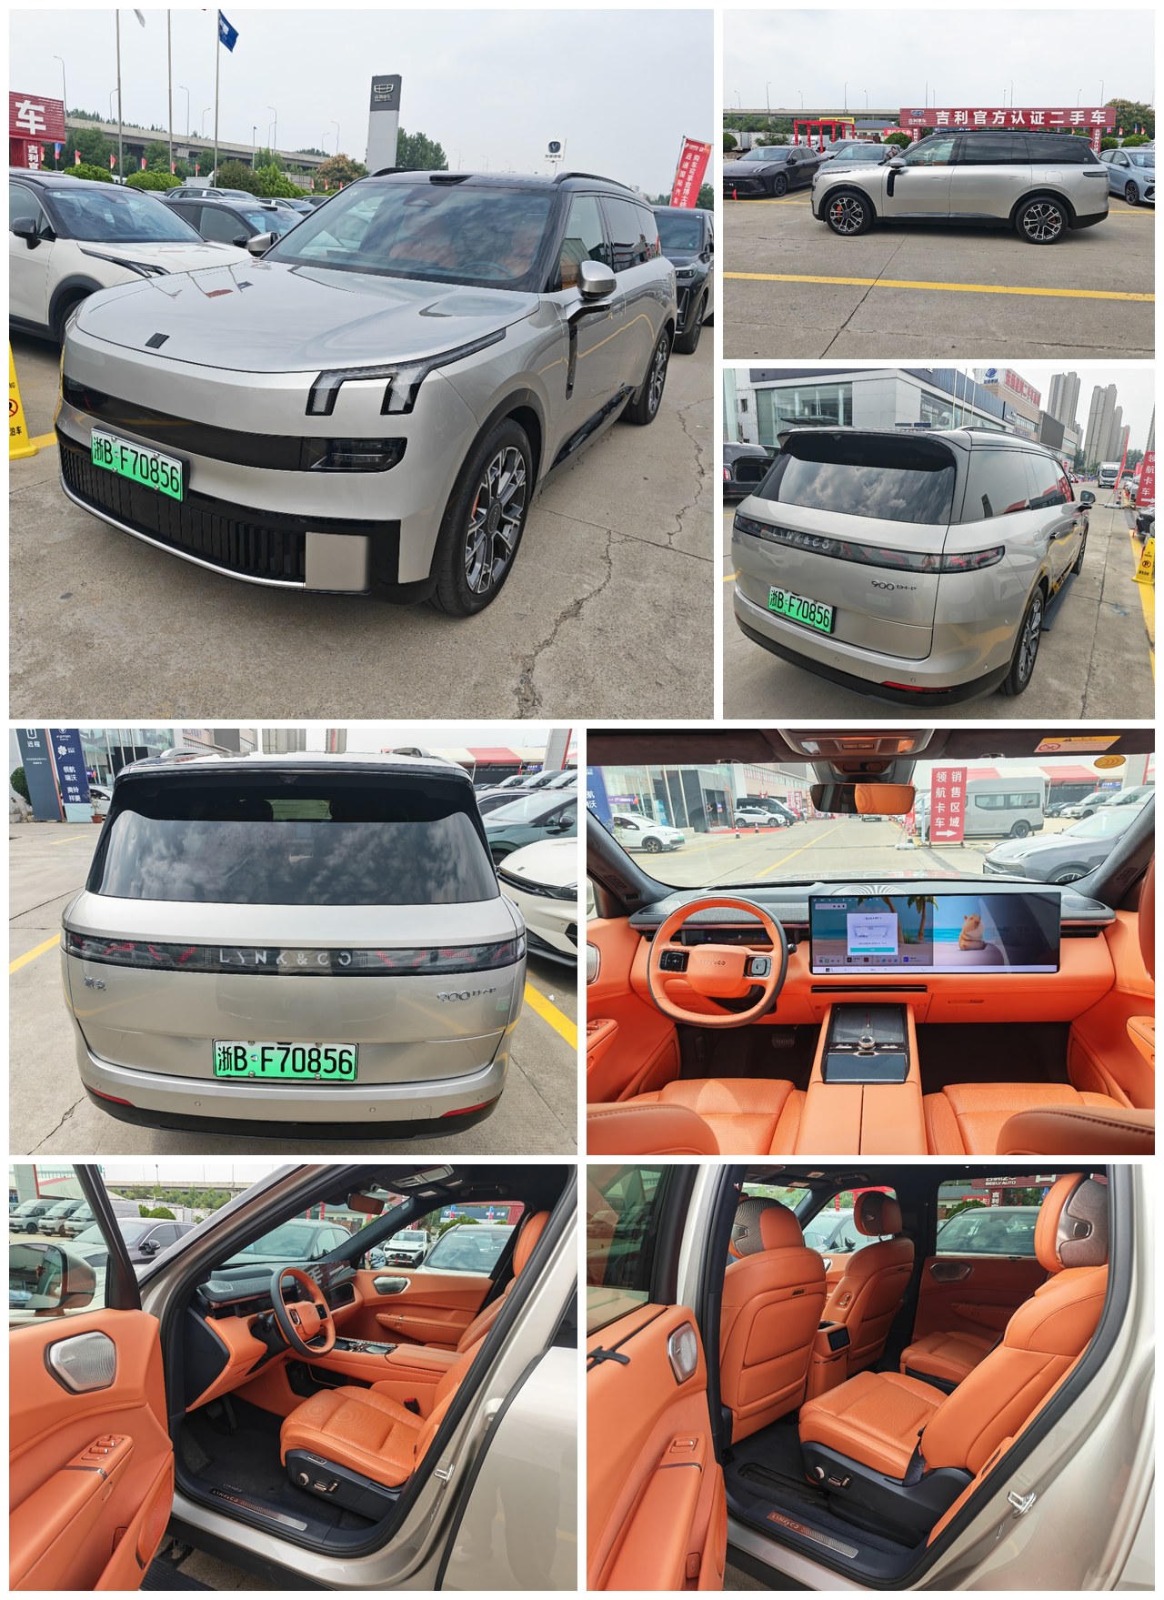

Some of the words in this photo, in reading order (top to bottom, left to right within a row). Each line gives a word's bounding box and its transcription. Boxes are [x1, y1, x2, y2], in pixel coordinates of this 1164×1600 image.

[15, 100, 46, 135] 车
[936, 110, 1106, 125] 吉利官方认证二手车
[871, 580, 895, 591] 900
[935, 772, 947, 828] 领航卡车
[950, 771, 962, 828] 销售区域
